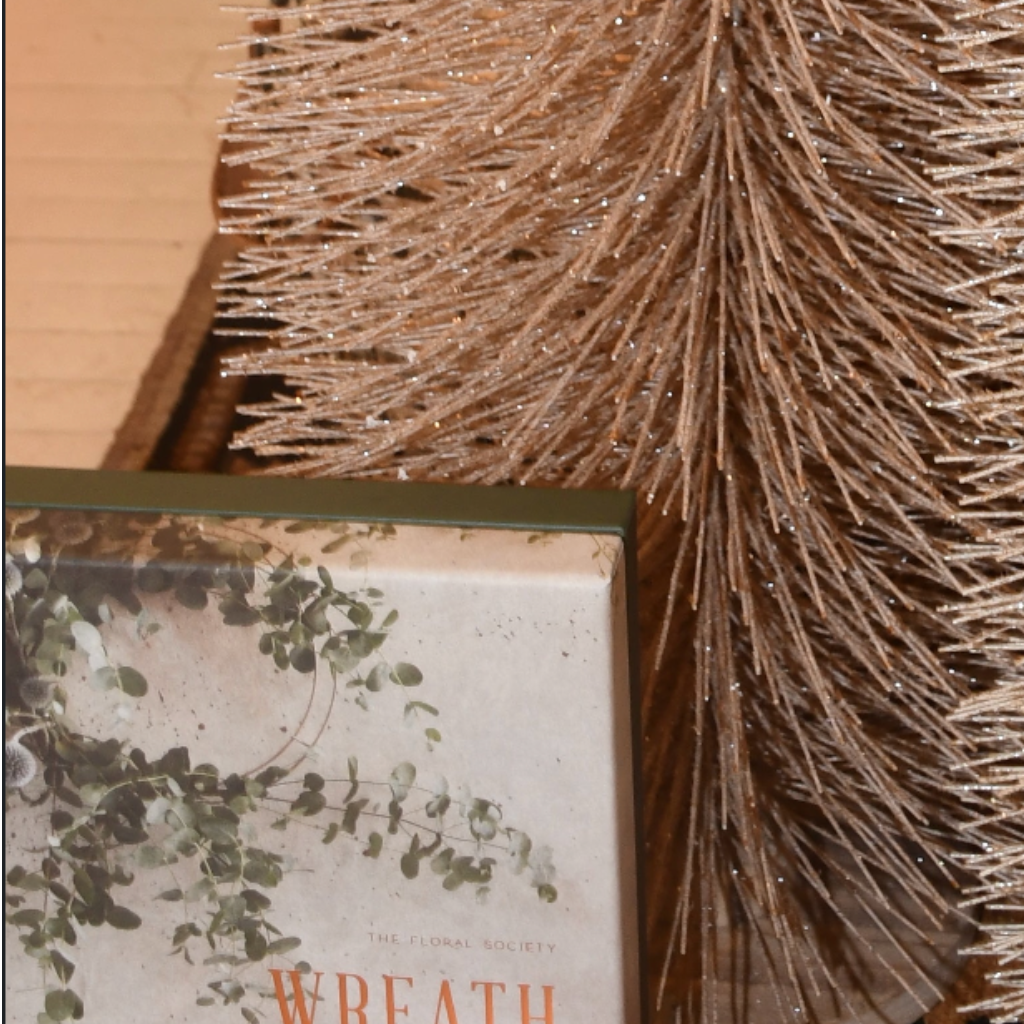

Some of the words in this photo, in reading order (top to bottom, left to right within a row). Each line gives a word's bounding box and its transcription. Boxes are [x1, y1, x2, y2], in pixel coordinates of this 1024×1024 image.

[368, 932, 400, 945] THE
[410, 935, 472, 950] FLORAL
[483, 940, 557, 954] SOCIETY
[269, 969, 555, 1024] WREATH
